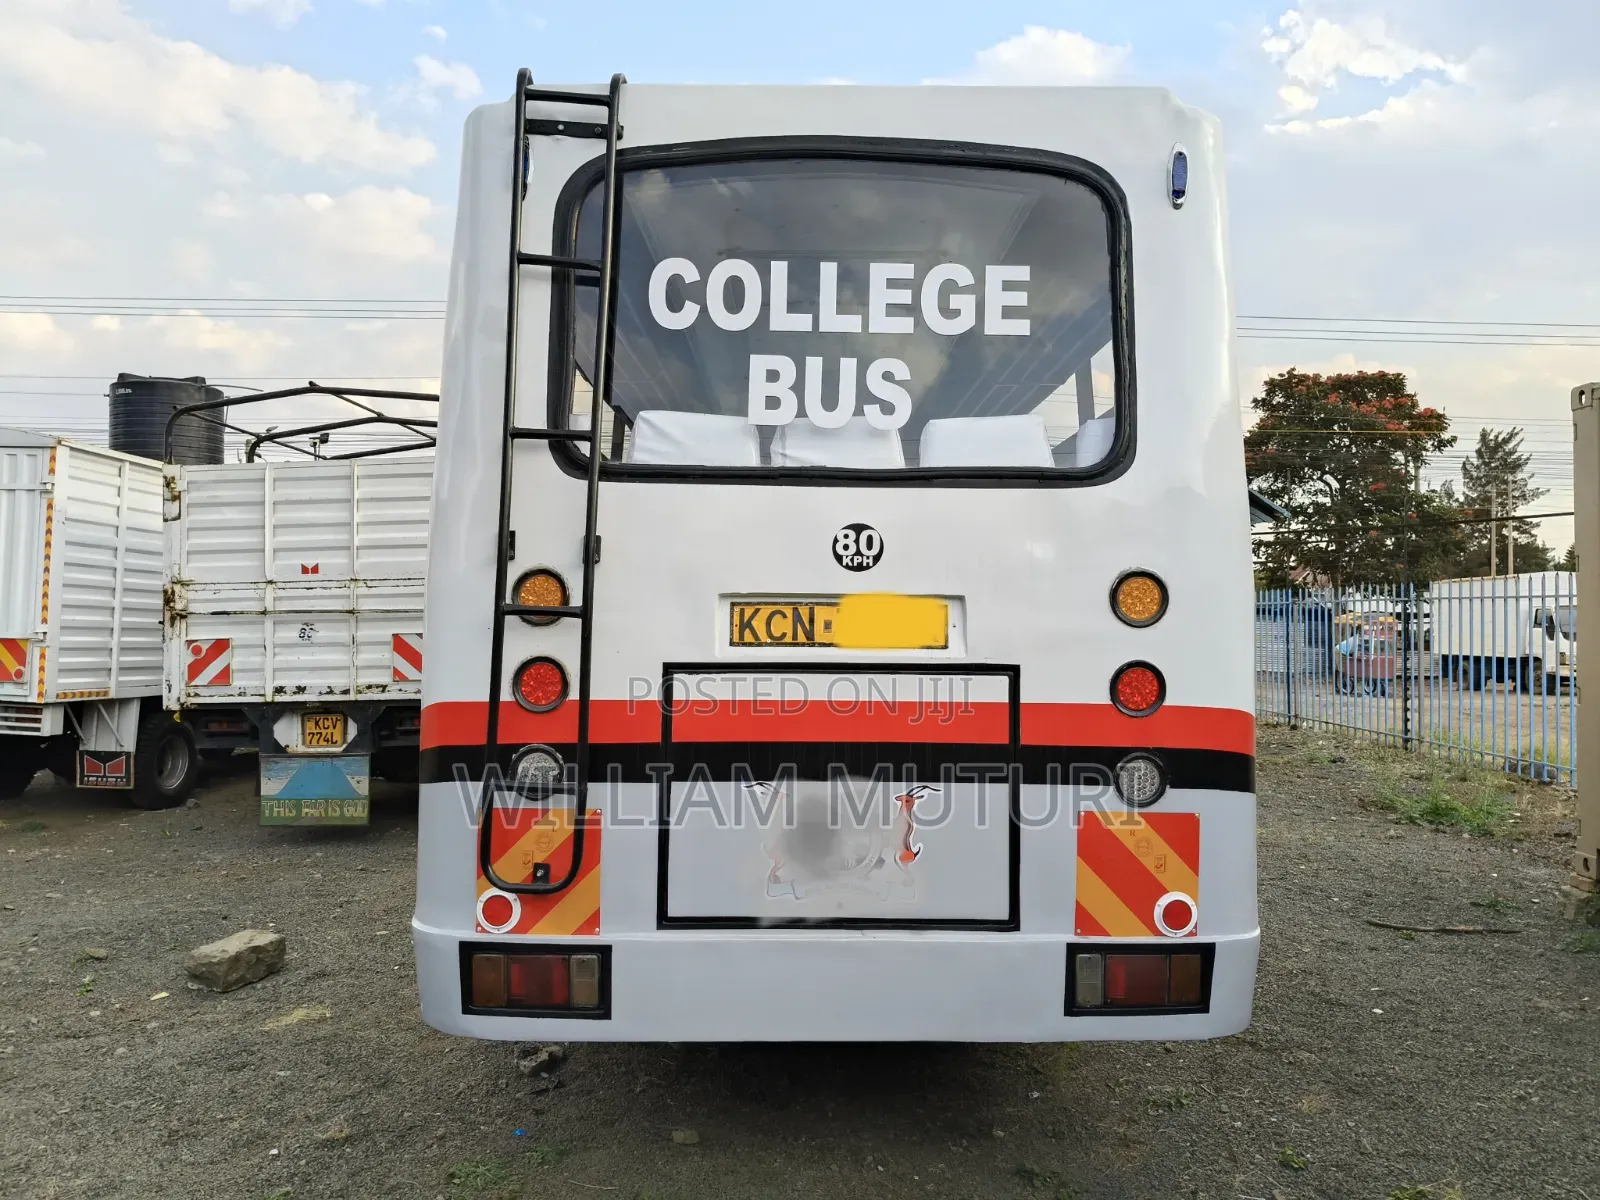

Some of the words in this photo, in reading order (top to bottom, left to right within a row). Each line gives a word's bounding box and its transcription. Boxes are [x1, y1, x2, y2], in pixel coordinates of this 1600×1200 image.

[648, 257, 1031, 336] COLLEGE
[748, 353, 912, 430] BUS
[835, 528, 881, 556] 80
[842, 555, 874, 567] KPH
[738, 606, 816, 642] KCN
[313, 716, 340, 731] KCV
[307, 731, 338, 745] 774L
[262, 800, 297, 817] THIS
[301, 799, 327, 817] FAR
[343, 799, 369, 817] GOD
